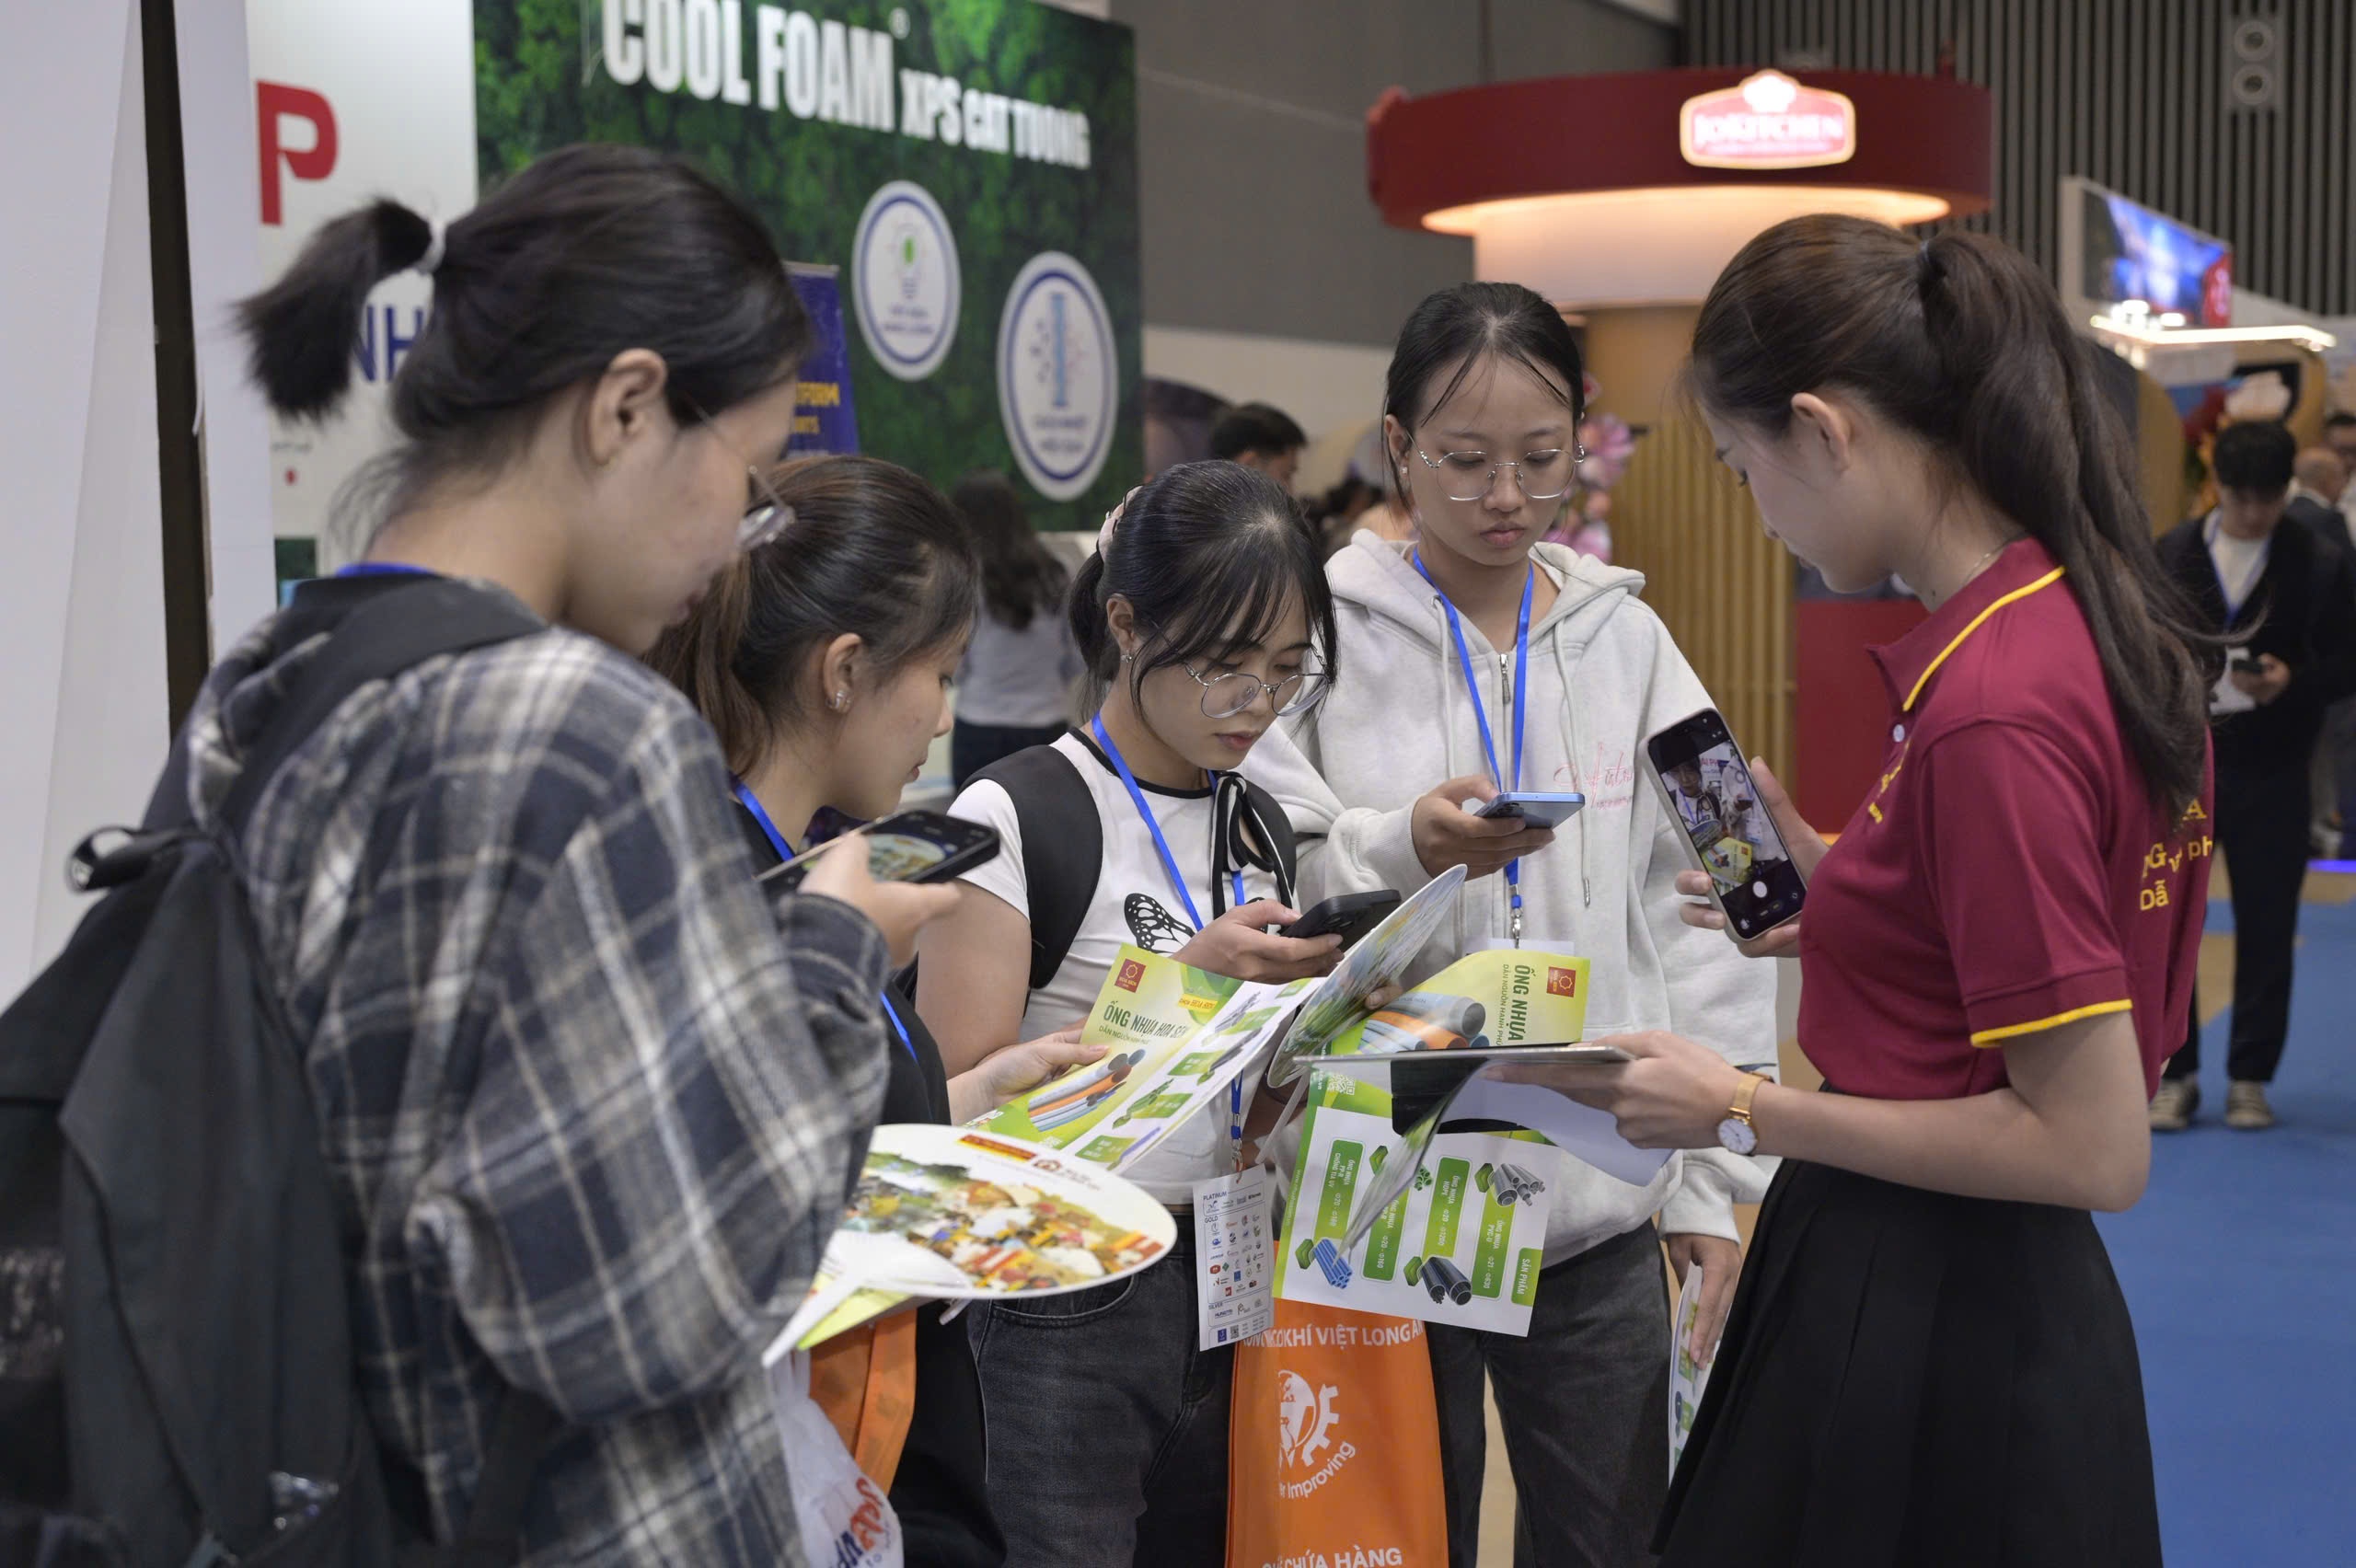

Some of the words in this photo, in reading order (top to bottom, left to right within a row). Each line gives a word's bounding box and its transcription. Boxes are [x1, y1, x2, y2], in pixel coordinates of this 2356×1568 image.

[602, 0, 751, 106] COOL
[899, 67, 963, 146] XPS
[2140, 879, 2170, 912] Dẫ
[1512, 964, 1536, 996] ỐNG
[1103, 1000, 1131, 1028] ỐNG
[1130, 1014, 1159, 1037] NHỰA
[1506, 999, 1528, 1041] NHỰA
[1204, 1216, 1218, 1224] GOLD
[1316, 1323, 1357, 1350] VIỆT
[1362, 1323, 1411, 1347] LONG
[1288, 1440, 1357, 1499] Improving
[1334, 1543, 1403, 1568] HÀNG
